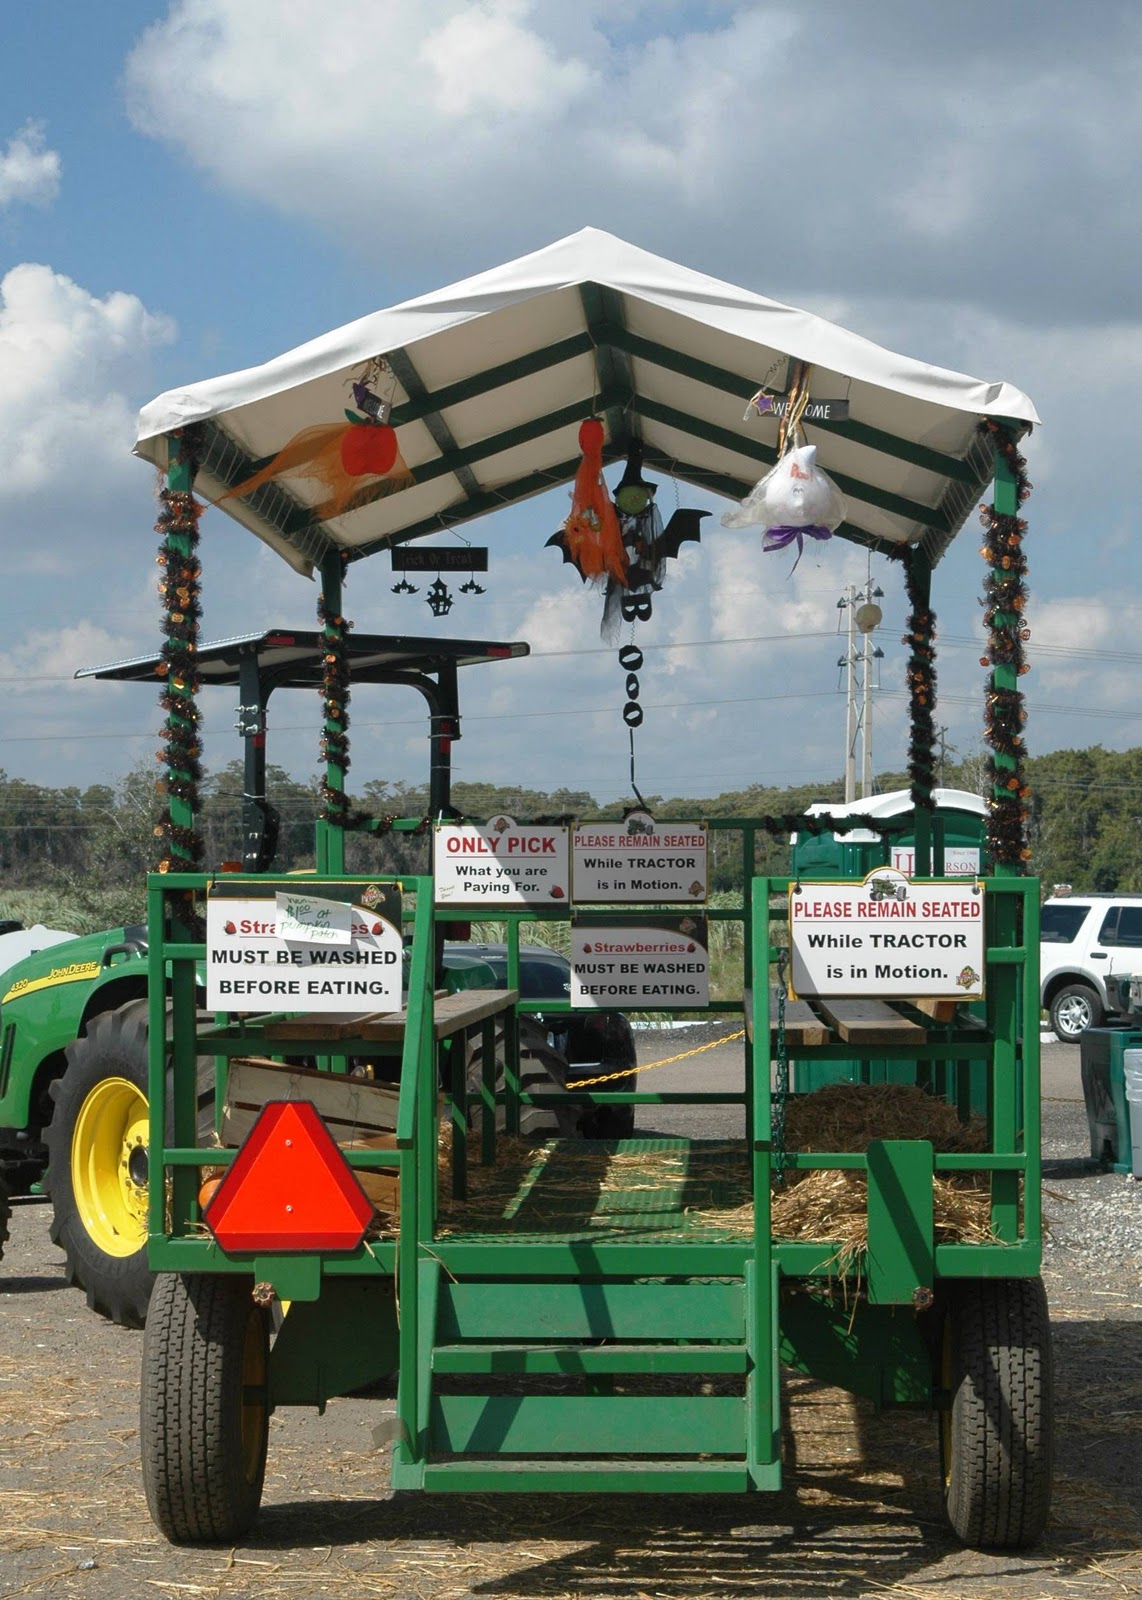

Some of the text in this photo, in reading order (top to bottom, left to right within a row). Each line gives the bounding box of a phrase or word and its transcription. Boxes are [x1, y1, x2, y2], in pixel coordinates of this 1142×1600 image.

[773, 402, 831, 419] WEOME
[446, 836, 556, 853] ONLY PICK
[574, 835, 705, 847] PLEASE REMAIN SEATED
[584, 858, 696, 869] While TRACTOR
[455, 866, 548, 878] What you are
[463, 881, 540, 895] Paying For.
[597, 879, 682, 891] is in Motion.
[317, 909, 332, 919] at
[794, 901, 981, 918] PLEASE REMAIN SEATED
[594, 941, 686, 953] Strawberries
[807, 934, 968, 948] While TRACTOR
[211, 950, 397, 965] MUST BE WASHED
[47, 966, 69, 980] JOHN
[68, 961, 97, 975] DEERE
[574, 963, 706, 974] MUST BE WASHED
[826, 965, 949, 979] is in Motion.
[219, 980, 390, 995] BEFORE EATING.
[580, 984, 701, 995] BEFORE EATING.
